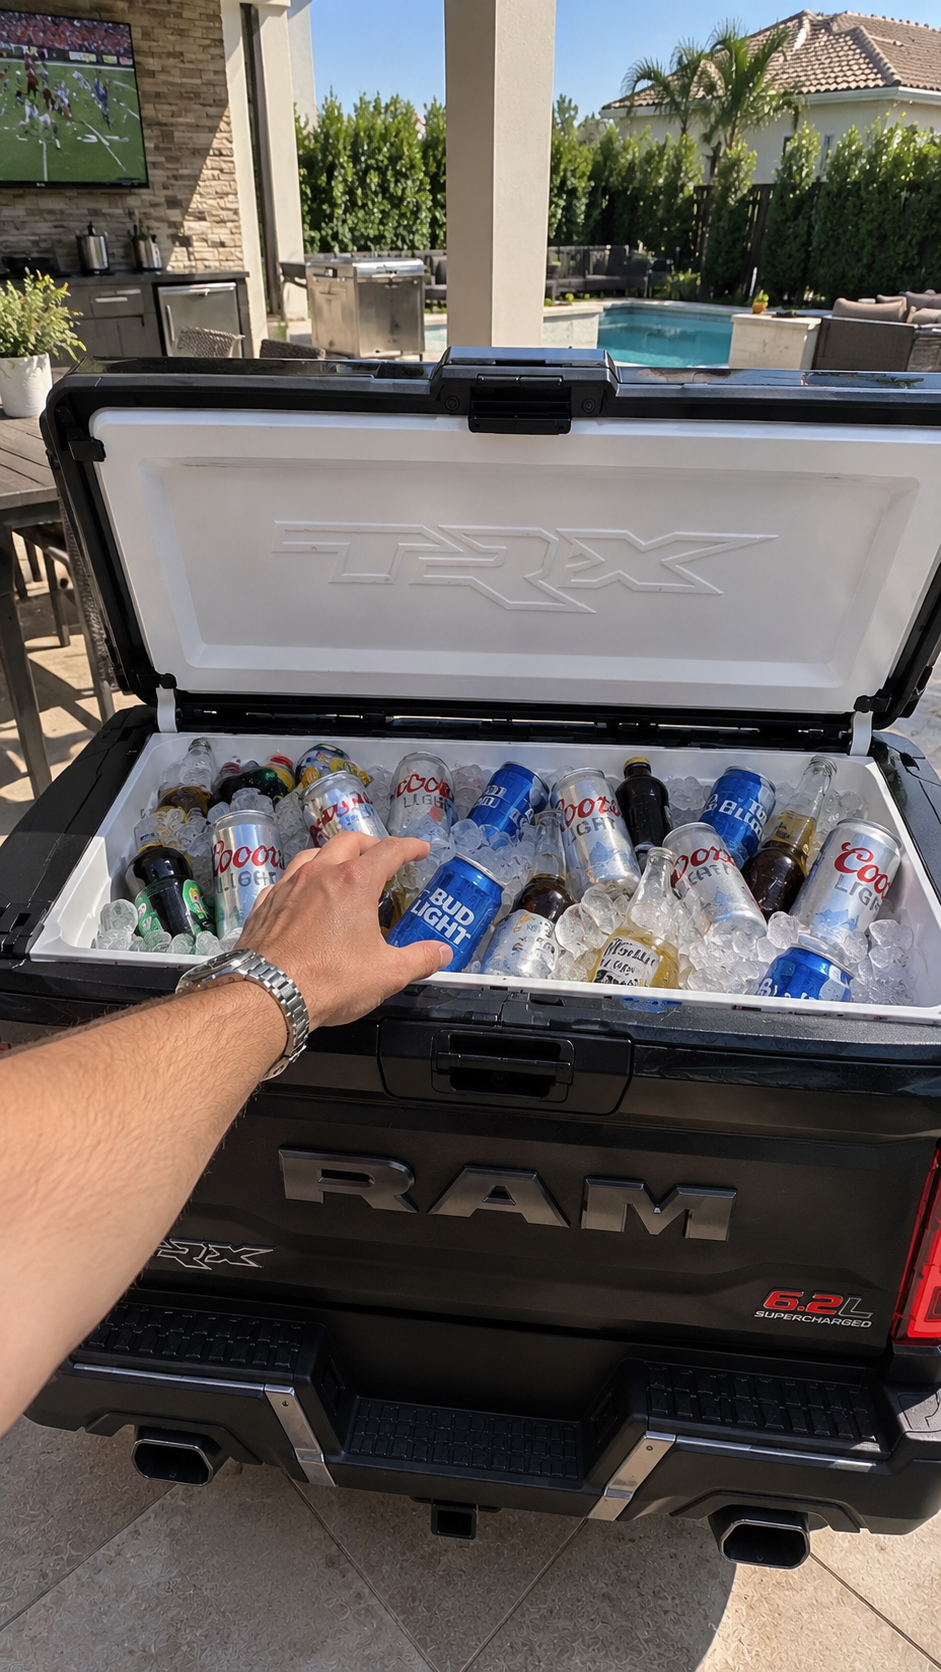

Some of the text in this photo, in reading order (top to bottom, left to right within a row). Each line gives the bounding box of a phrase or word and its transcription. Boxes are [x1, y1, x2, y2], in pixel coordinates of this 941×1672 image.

[271, 519, 779, 614] TRX
[410, 899, 468, 945] LIGHT
[429, 887, 475, 926] BUD
[278, 1146, 737, 1242] RAM
[157, 1237, 275, 1271] RX
[753, 1310, 872, 1328] SUPERCHARGED
[763, 1289, 874, 1319] 6.2L
